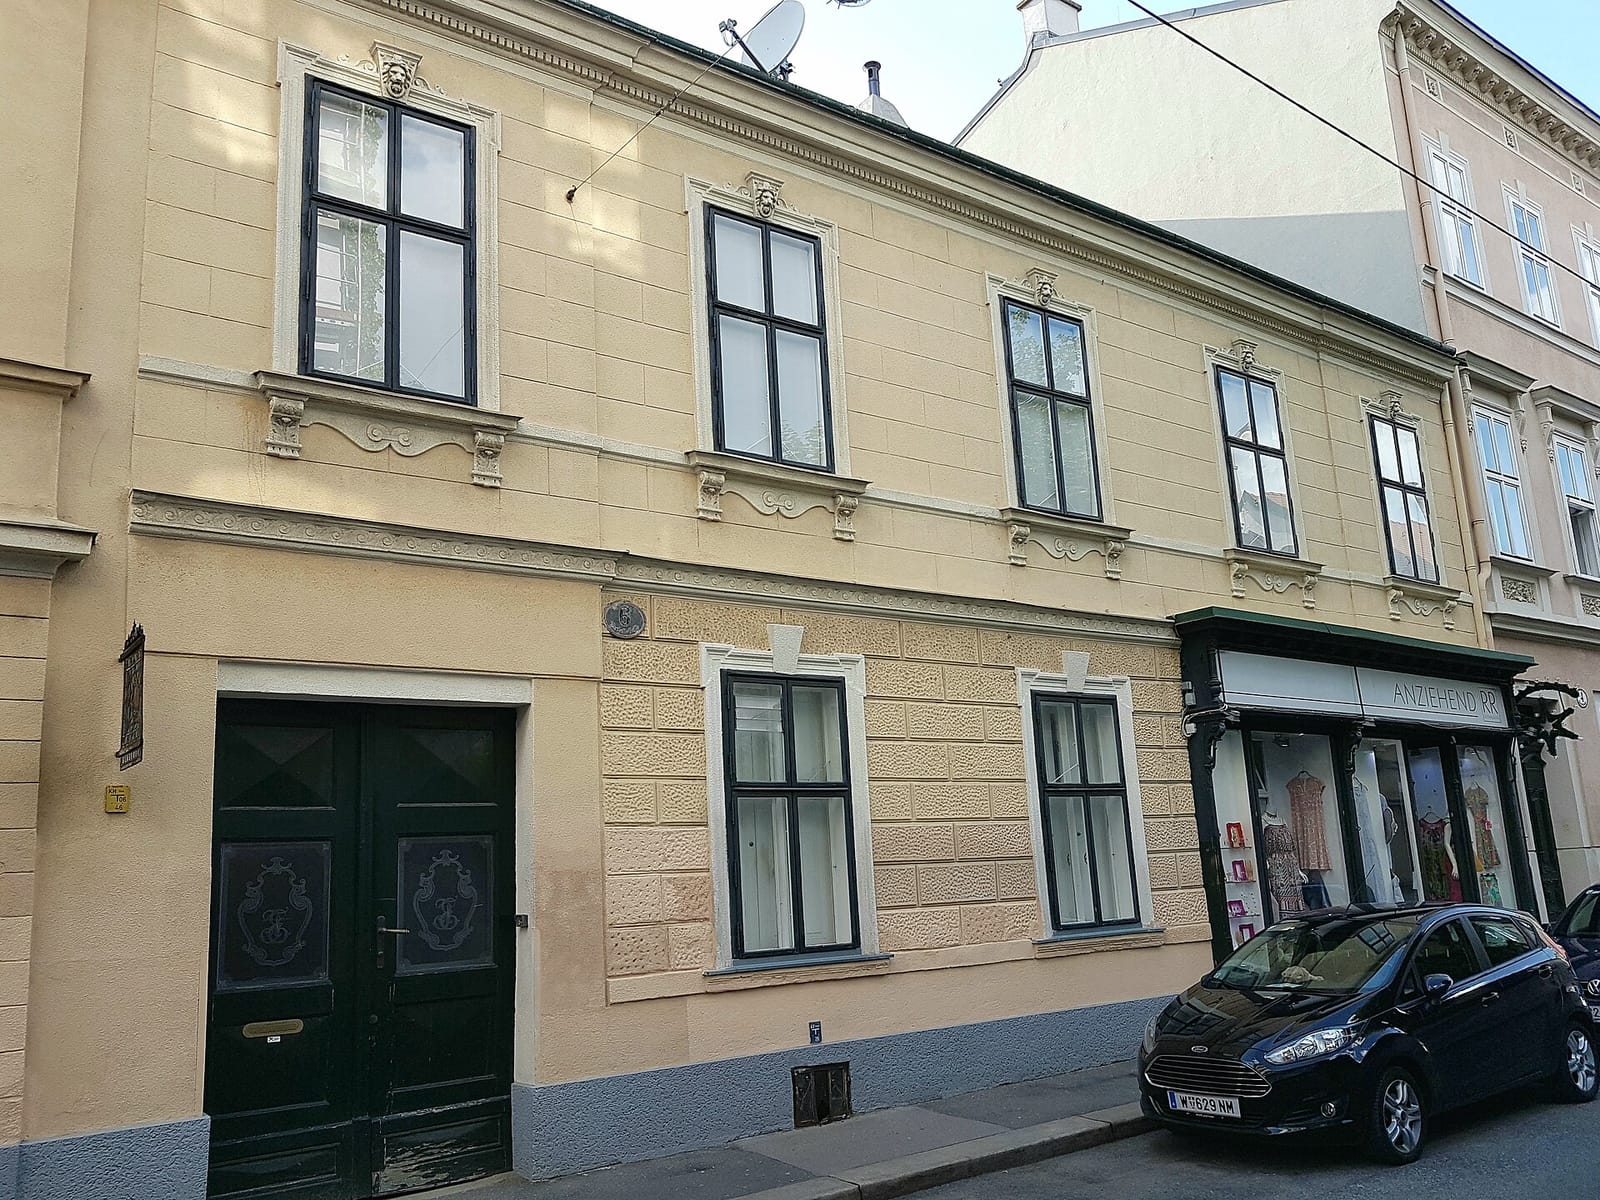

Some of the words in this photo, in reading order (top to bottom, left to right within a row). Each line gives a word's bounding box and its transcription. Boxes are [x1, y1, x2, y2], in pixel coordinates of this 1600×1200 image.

[619, 605, 631, 626] 6
[1393, 683, 1477, 711] ANZIEHEND
[1480, 690, 1498, 714] RR
[1180, 1096, 1188, 1109] W
[1196, 1097, 1217, 1112] 629
[1218, 1100, 1235, 1114] NM
